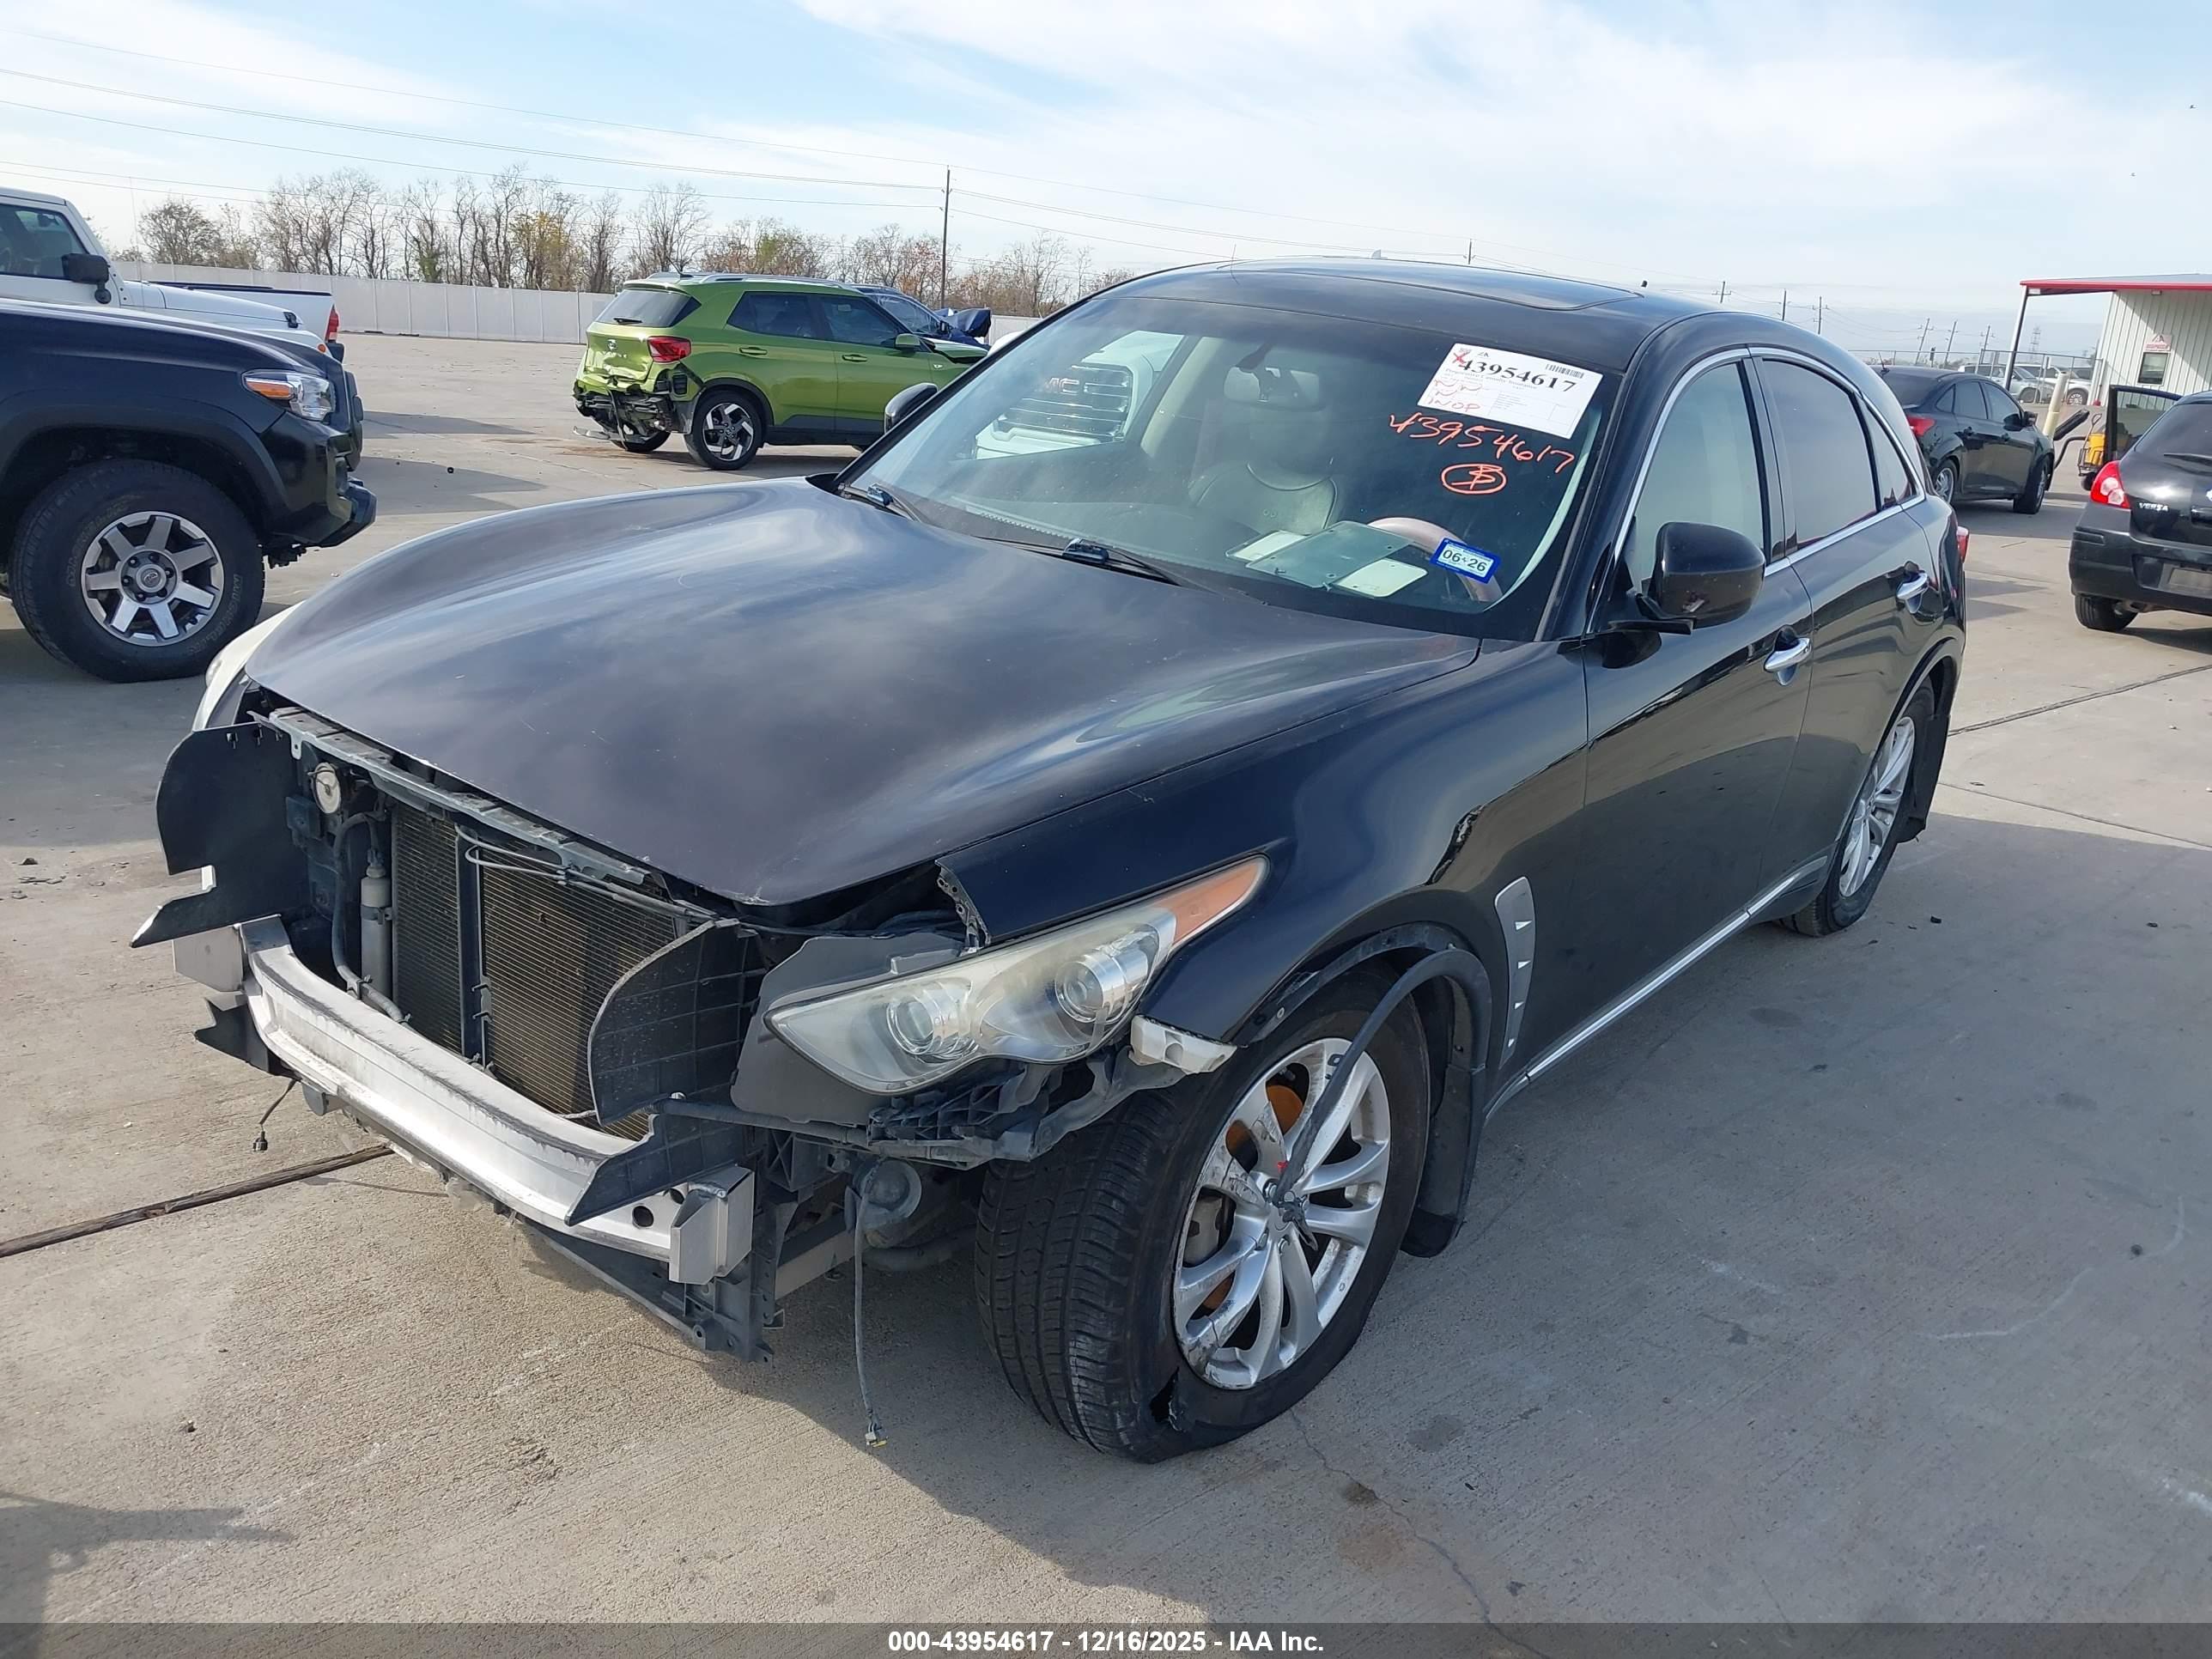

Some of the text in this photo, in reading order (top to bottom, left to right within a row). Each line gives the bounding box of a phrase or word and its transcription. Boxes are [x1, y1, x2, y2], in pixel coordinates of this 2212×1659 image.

[1458, 360, 1577, 392] 43954617
[1389, 412, 1575, 473] 43954617
[2139, 502, 2169, 513] VERSA
[1443, 550, 1462, 562] 06
[1468, 558, 1487, 572] 26
